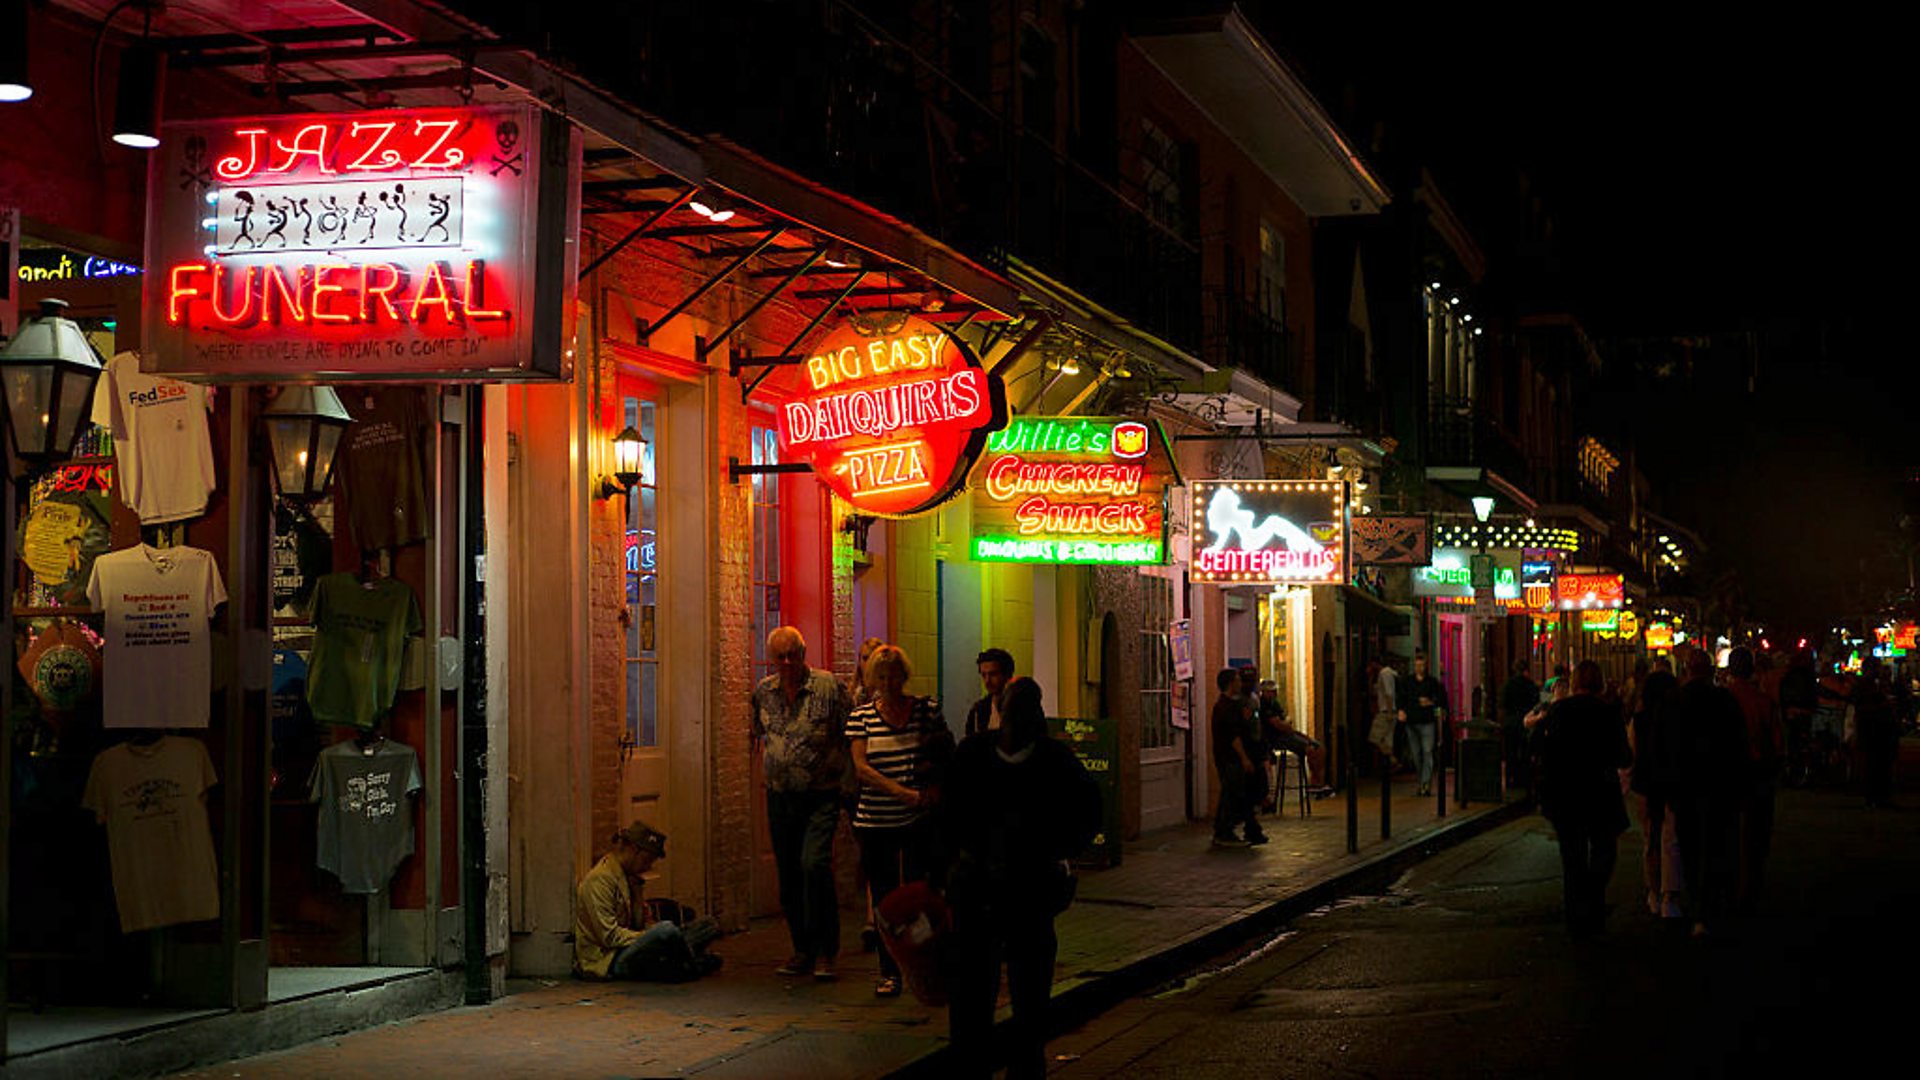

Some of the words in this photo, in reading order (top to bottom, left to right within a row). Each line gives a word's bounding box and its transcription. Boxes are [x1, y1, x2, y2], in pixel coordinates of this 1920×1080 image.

[216, 119, 464, 179] JAZZ
[169, 260, 504, 323] FUNERAL
[386, 340, 404, 356] TO
[410, 338, 456, 357] COME
[808, 346, 861, 390] BIG
[868, 333, 945, 373] EASY
[129, 384, 187, 404] FedSex
[785, 370, 980, 445] DAIQUIRIS
[988, 421, 1107, 452] Willie's
[849, 446, 925, 491] PIZZA
[986, 454, 1143, 500] CHICKEN
[1016, 496, 1147, 534] SHACK
[1526, 586, 1551, 610] CLUB
